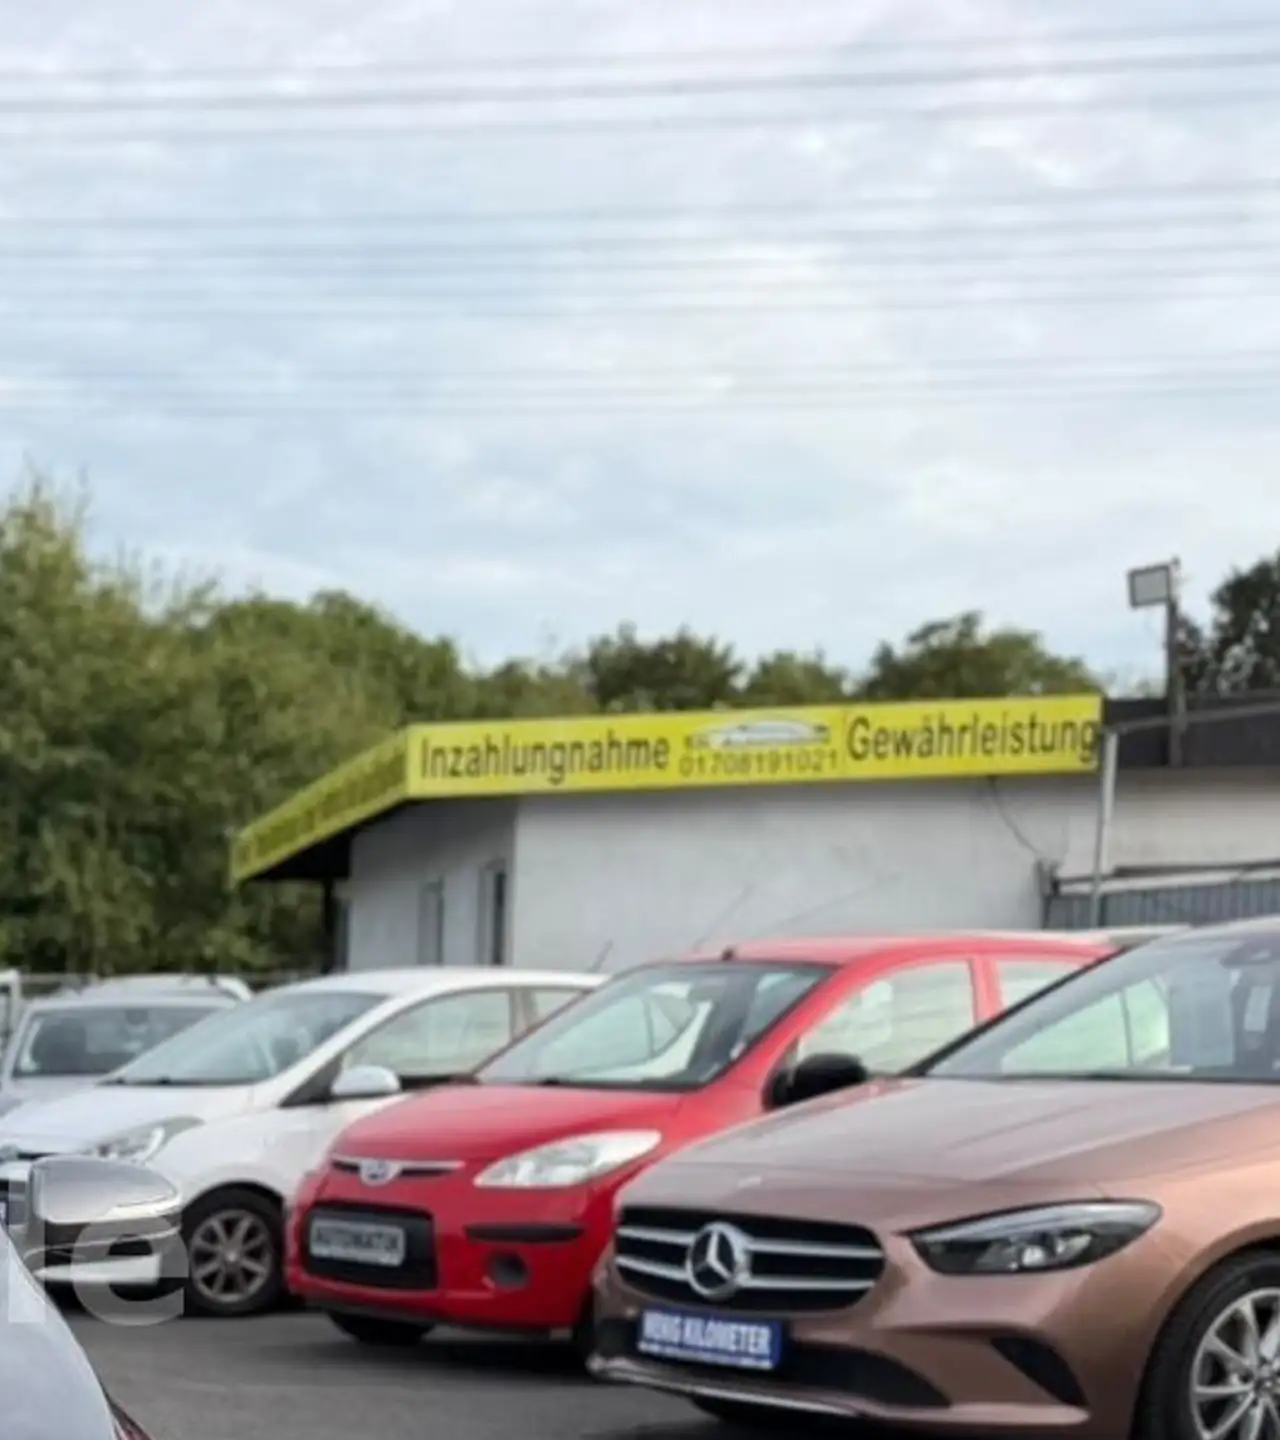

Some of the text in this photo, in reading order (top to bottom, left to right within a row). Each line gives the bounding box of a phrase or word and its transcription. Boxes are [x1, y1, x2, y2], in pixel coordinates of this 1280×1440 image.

[420, 729, 670, 786] Inzahlungnahme
[678, 748, 838, 777] 01708191021
[846, 714, 1099, 764] Gewährleistung
